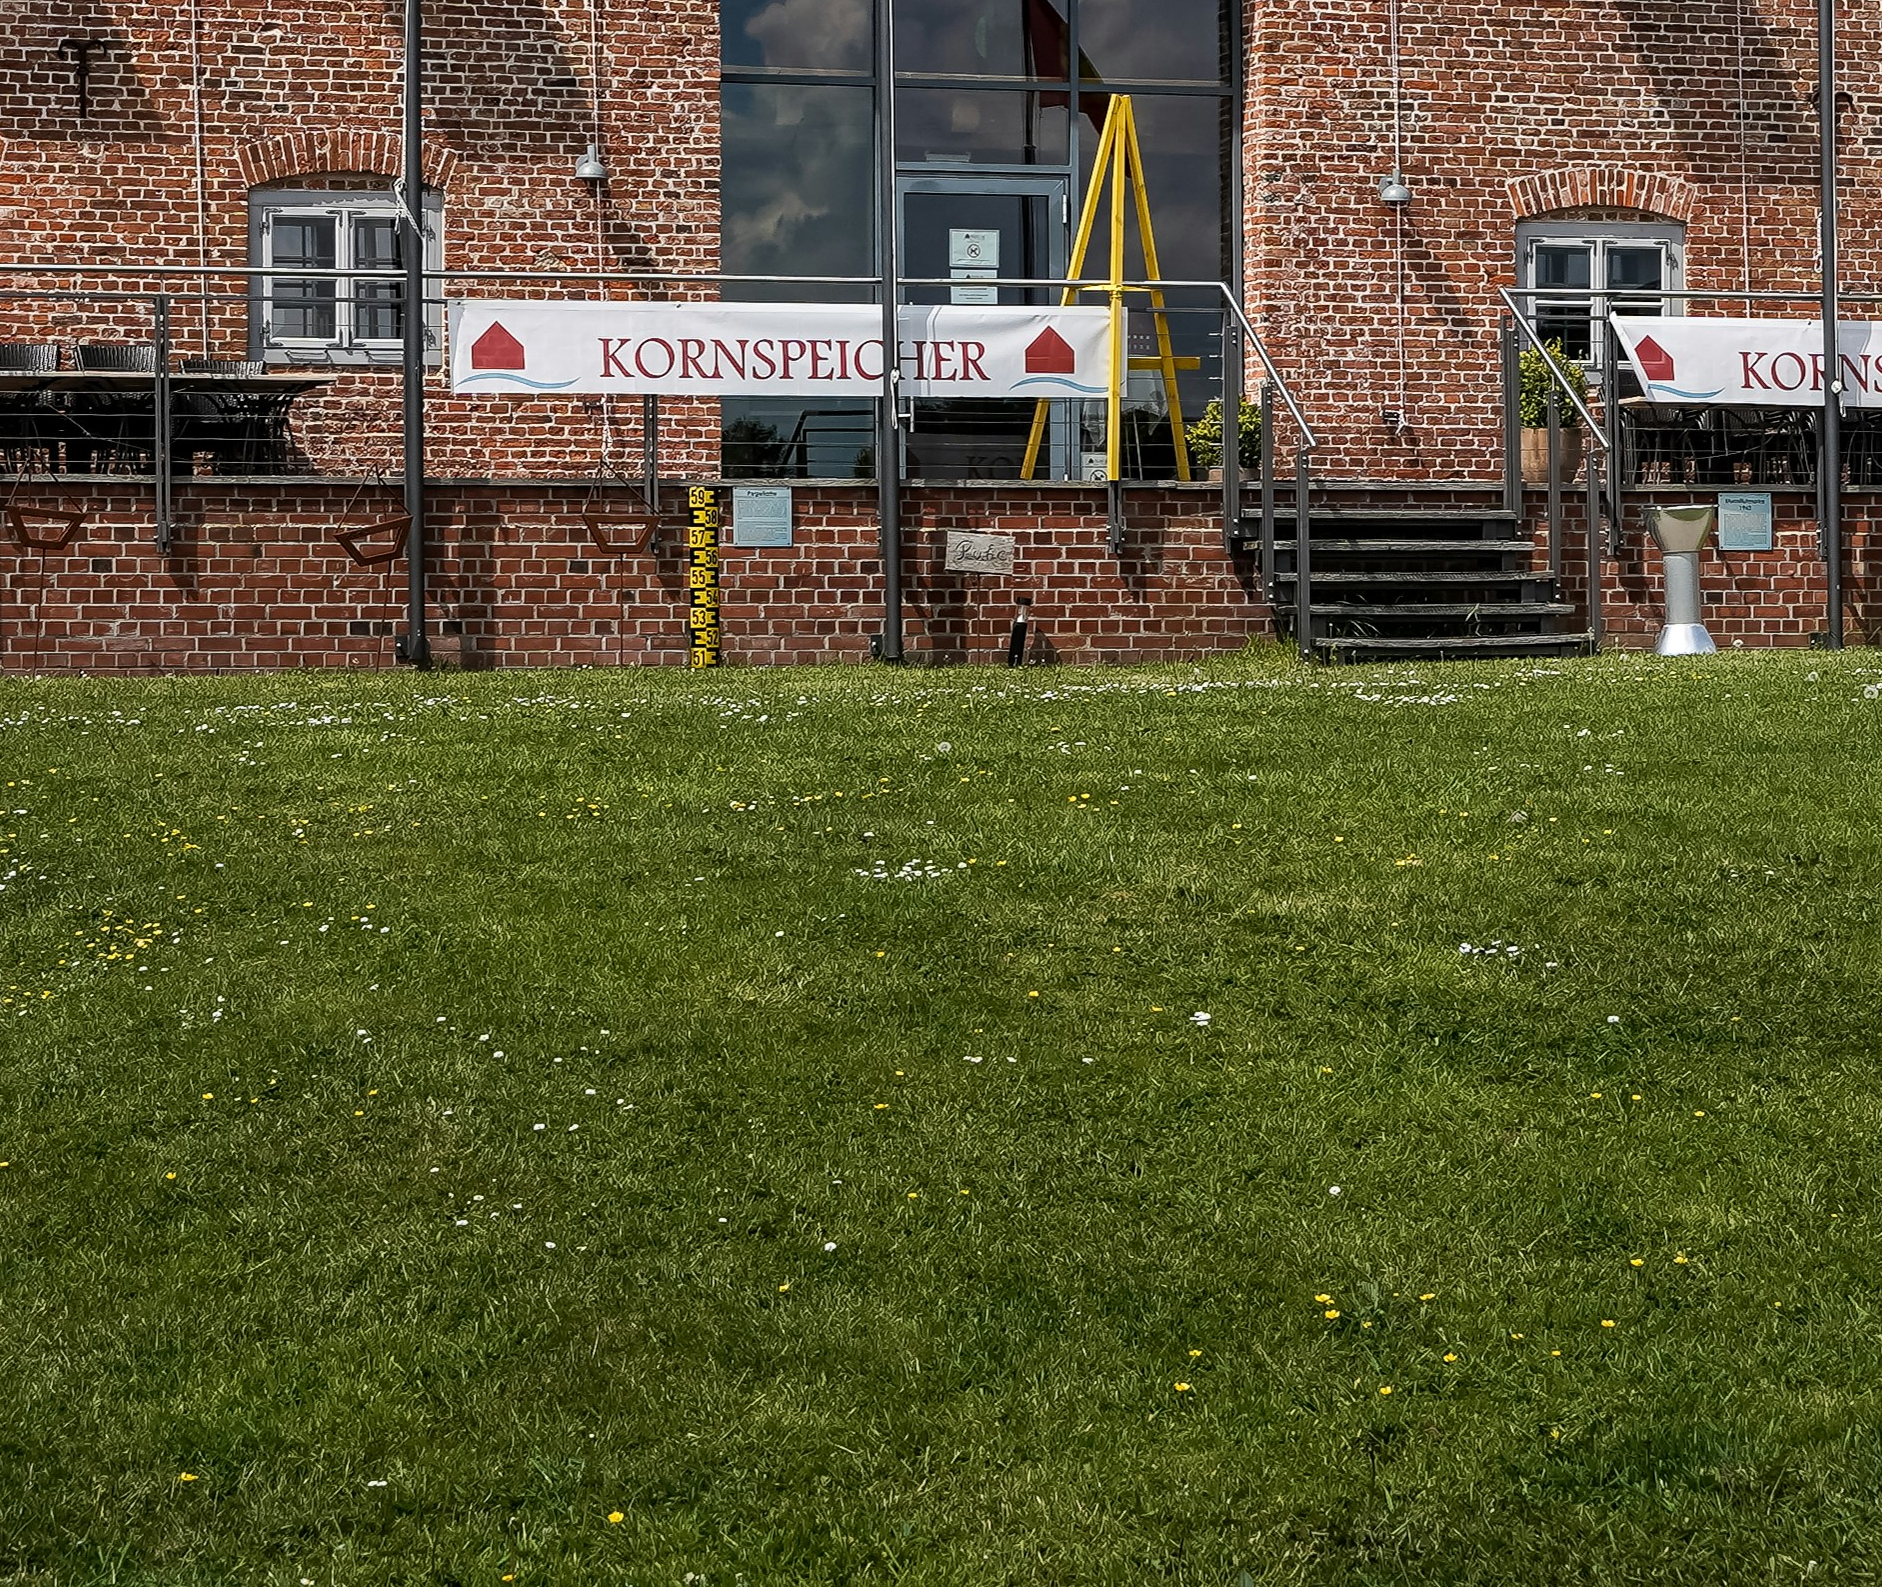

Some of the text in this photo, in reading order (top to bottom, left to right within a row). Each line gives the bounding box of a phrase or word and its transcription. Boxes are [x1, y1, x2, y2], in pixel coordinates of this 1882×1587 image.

[597, 337, 992, 381] KORNSPEICHER
[690, 489, 705, 505] 59
[705, 509, 718, 525] 58
[691, 529, 705, 545] 57
[705, 550, 718, 565] 56
[691, 570, 705, 585] 55
[706, 590, 718, 605] 54
[692, 610, 706, 625] 53
[706, 630, 718, 645] 52
[693, 651, 705, 665] 51
